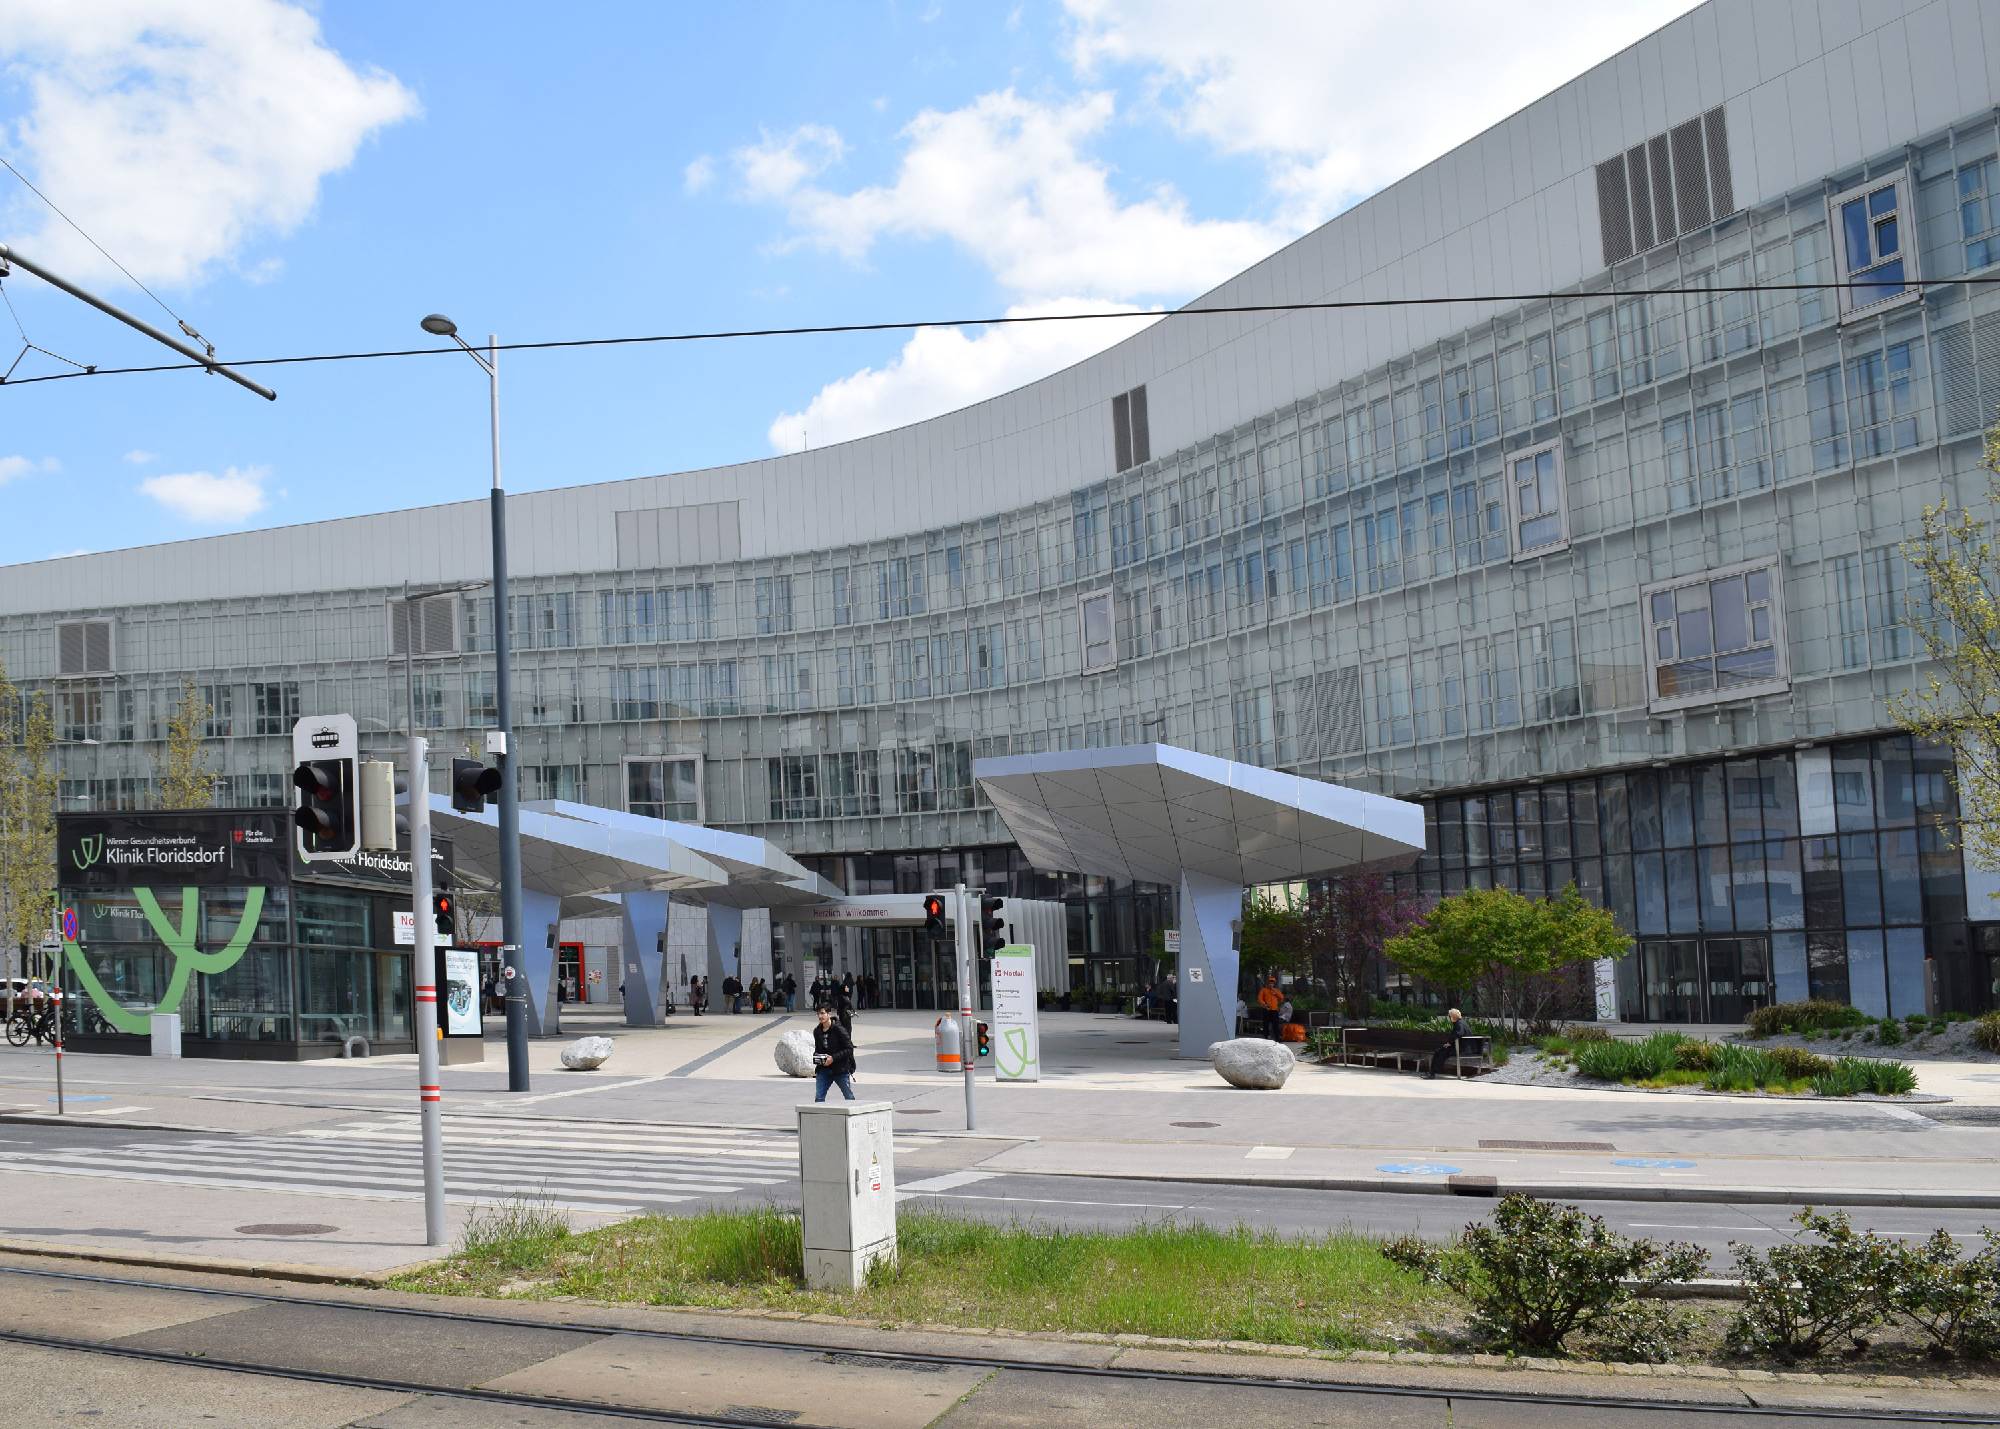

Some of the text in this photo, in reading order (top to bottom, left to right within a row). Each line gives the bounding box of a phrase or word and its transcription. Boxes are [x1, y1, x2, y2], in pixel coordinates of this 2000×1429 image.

[106, 836, 196, 845] Wiener Gesundheitsverbund
[106, 846, 225, 864] Klinik Floridsdorf
